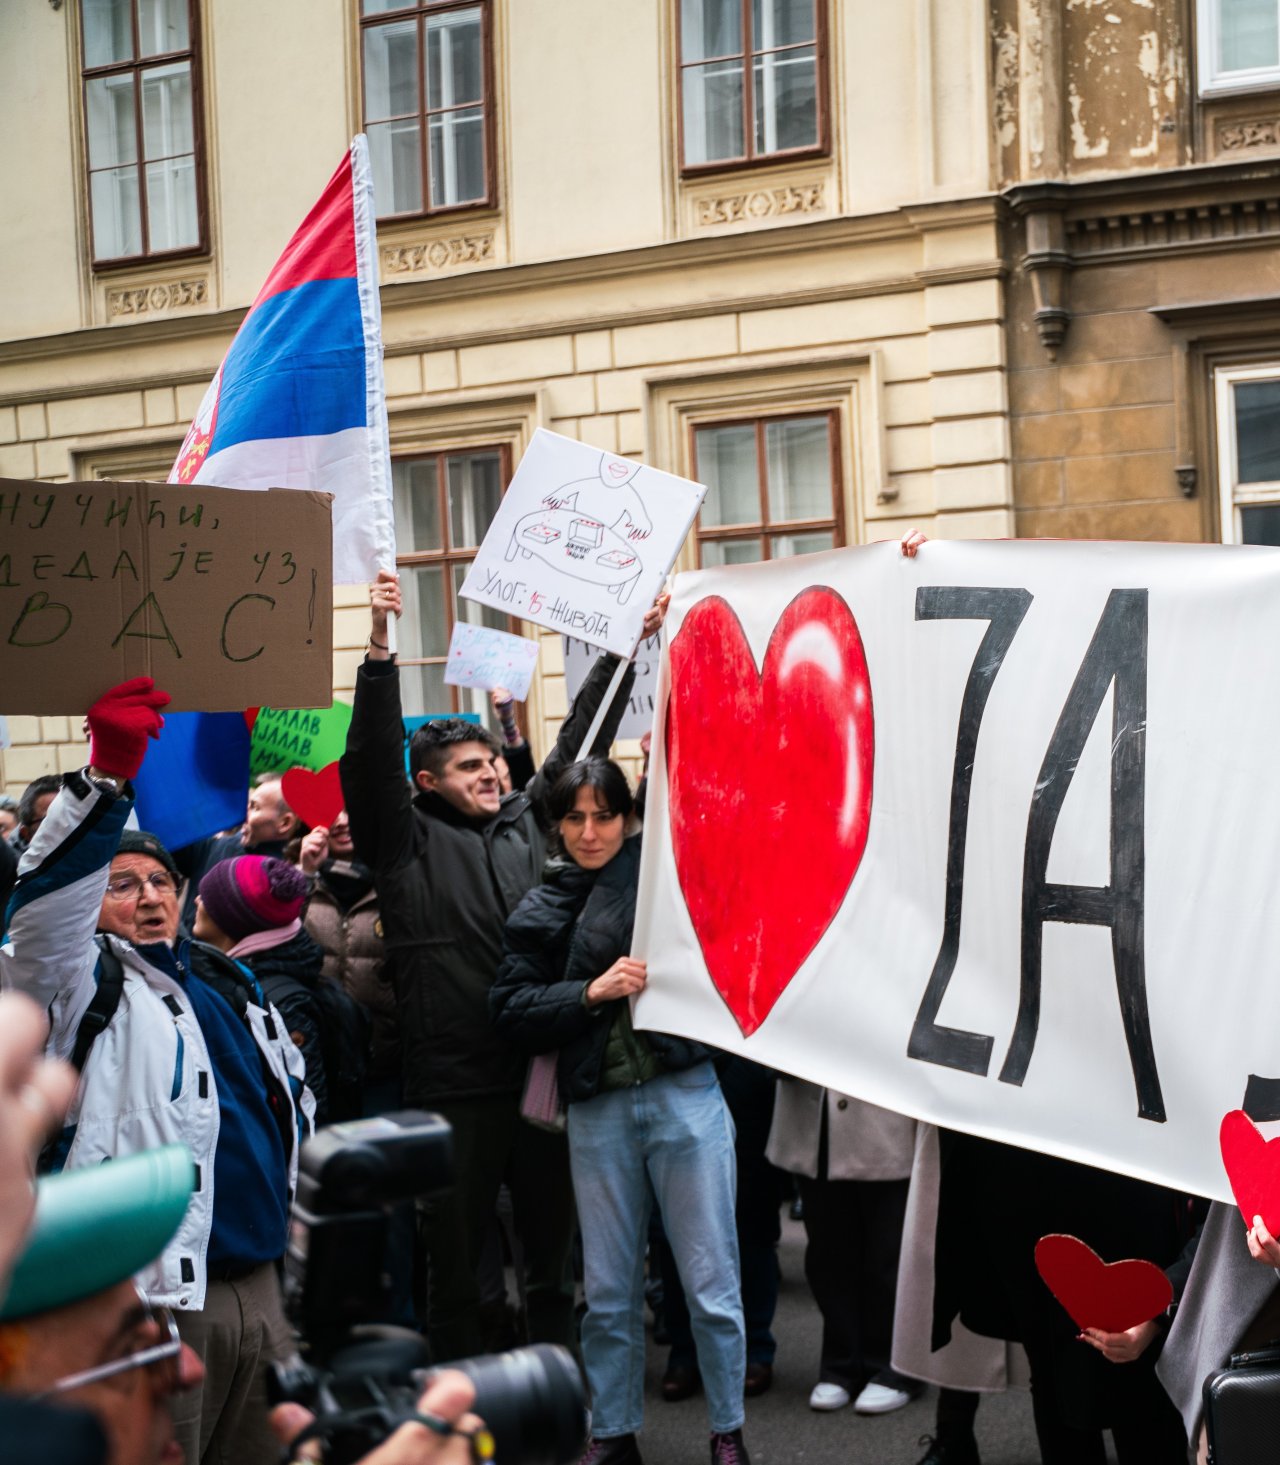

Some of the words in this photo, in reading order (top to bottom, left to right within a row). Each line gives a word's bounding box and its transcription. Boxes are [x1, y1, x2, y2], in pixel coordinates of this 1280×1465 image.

[252, 551, 297, 585] УЗ
[476, 567, 527, 605] УЛОГ:
[546, 596, 612, 640] ЖИВОТА
[907, 585, 1168, 1124] ZA
